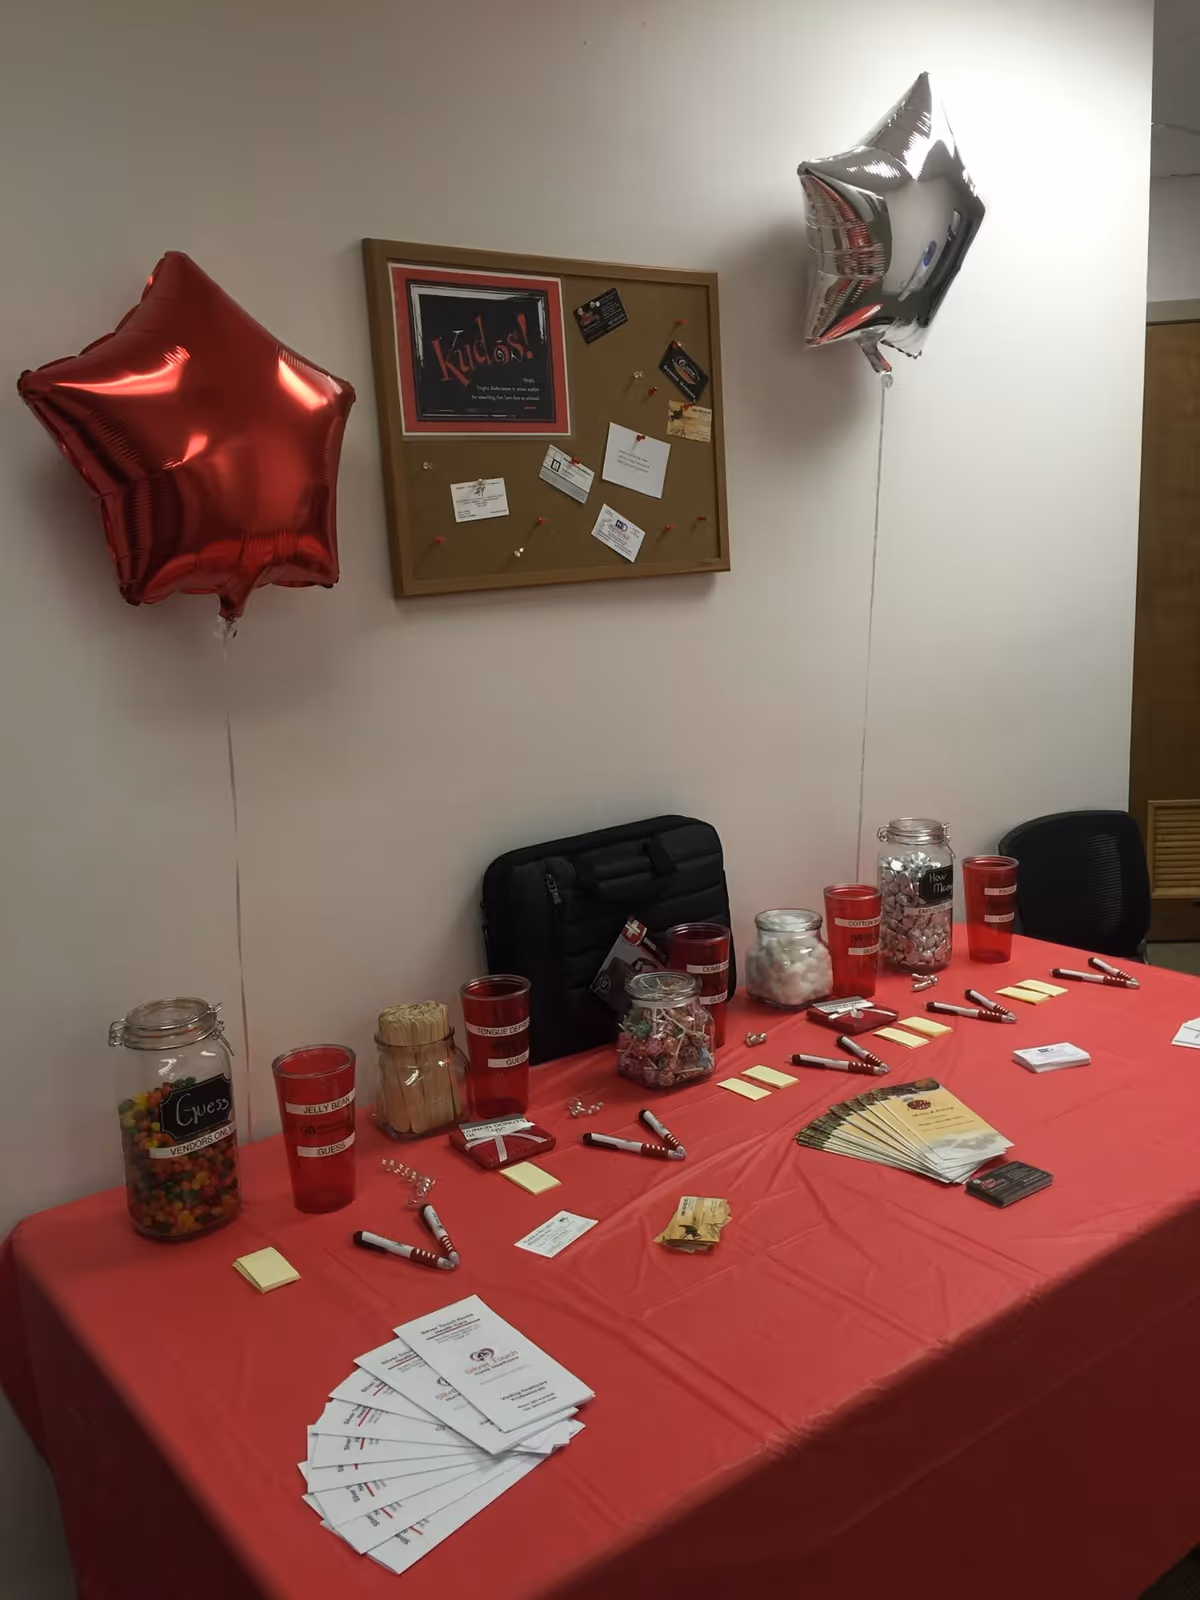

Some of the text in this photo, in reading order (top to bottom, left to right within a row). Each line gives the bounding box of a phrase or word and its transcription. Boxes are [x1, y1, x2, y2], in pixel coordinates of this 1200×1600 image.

[432, 312, 534, 387] Kudos!
[930, 873, 947, 883] How
[477, 1027, 509, 1035] TONGUE
[176, 1093, 229, 1126] Guess
[304, 1095, 351, 1114] JELLY BEAN
[170, 1126, 233, 1156] VENDORS ONLY
[317, 1142, 346, 1156] GUESS
[490, 1349, 519, 1364] Touch
